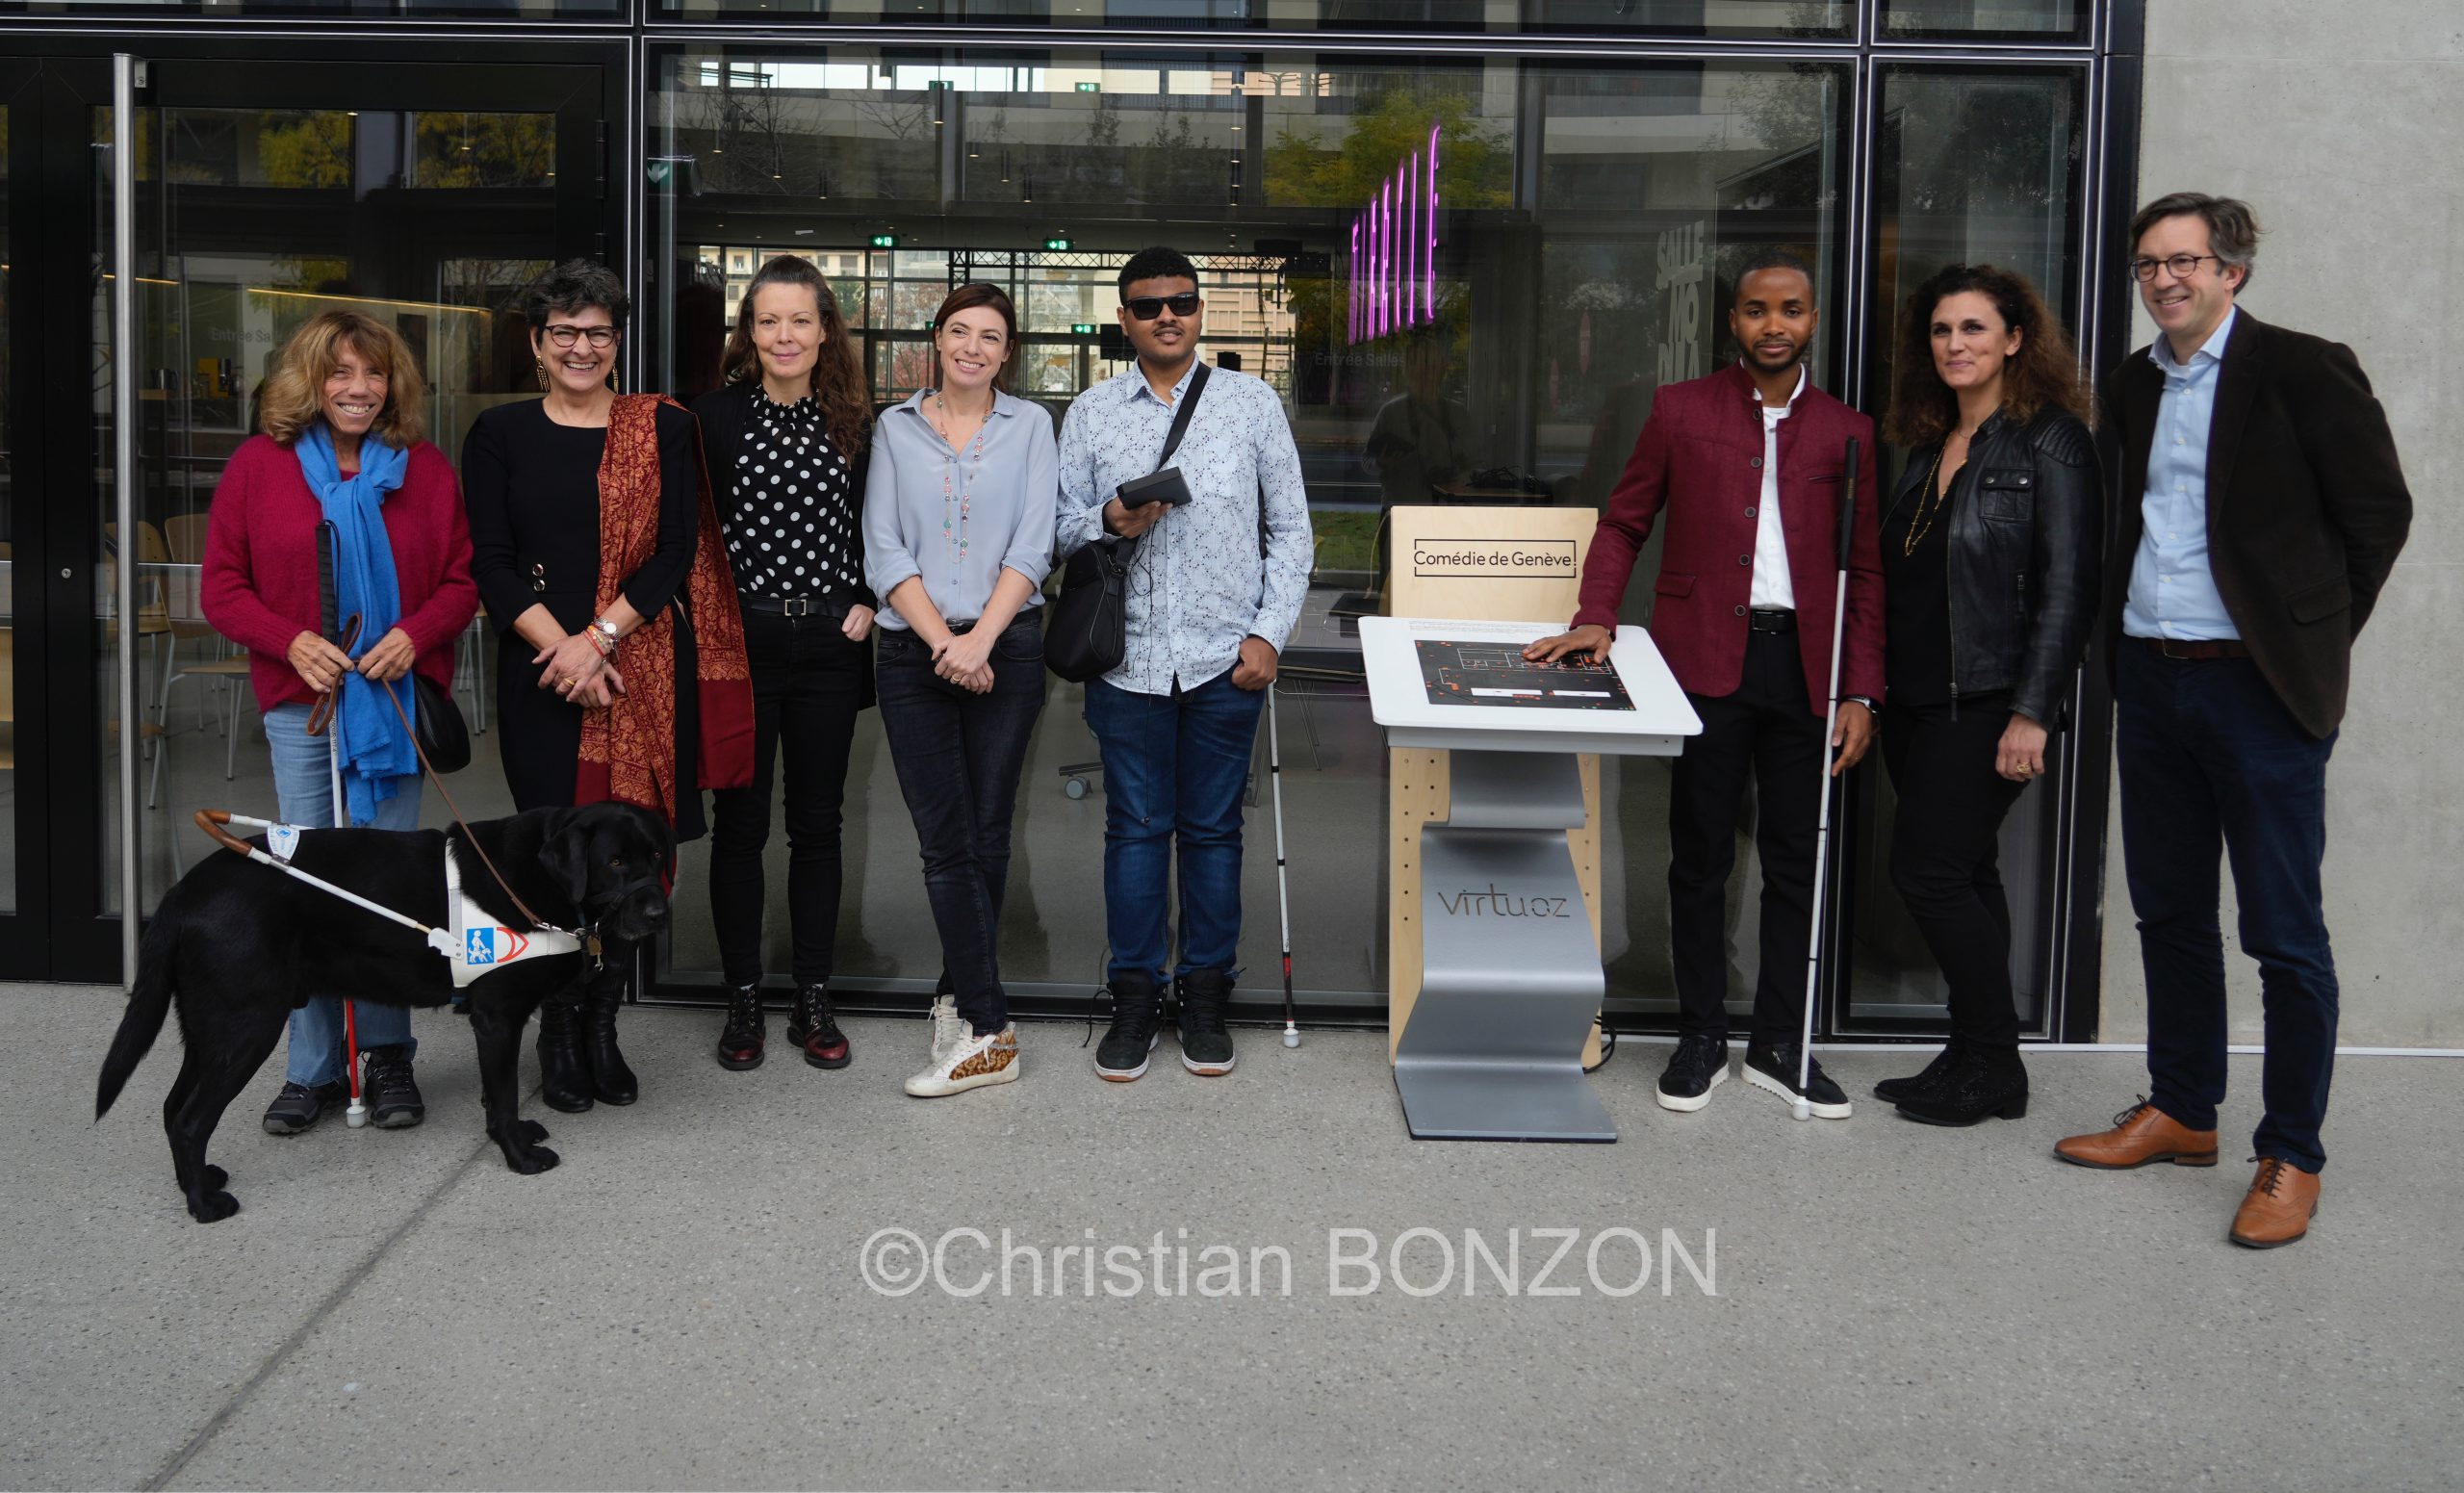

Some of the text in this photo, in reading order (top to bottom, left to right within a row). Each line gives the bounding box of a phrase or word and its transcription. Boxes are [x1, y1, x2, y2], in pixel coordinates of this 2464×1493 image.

[1414, 551, 1571, 566] Comédie de Genève
[1438, 884, 1570, 916] virtuoz
